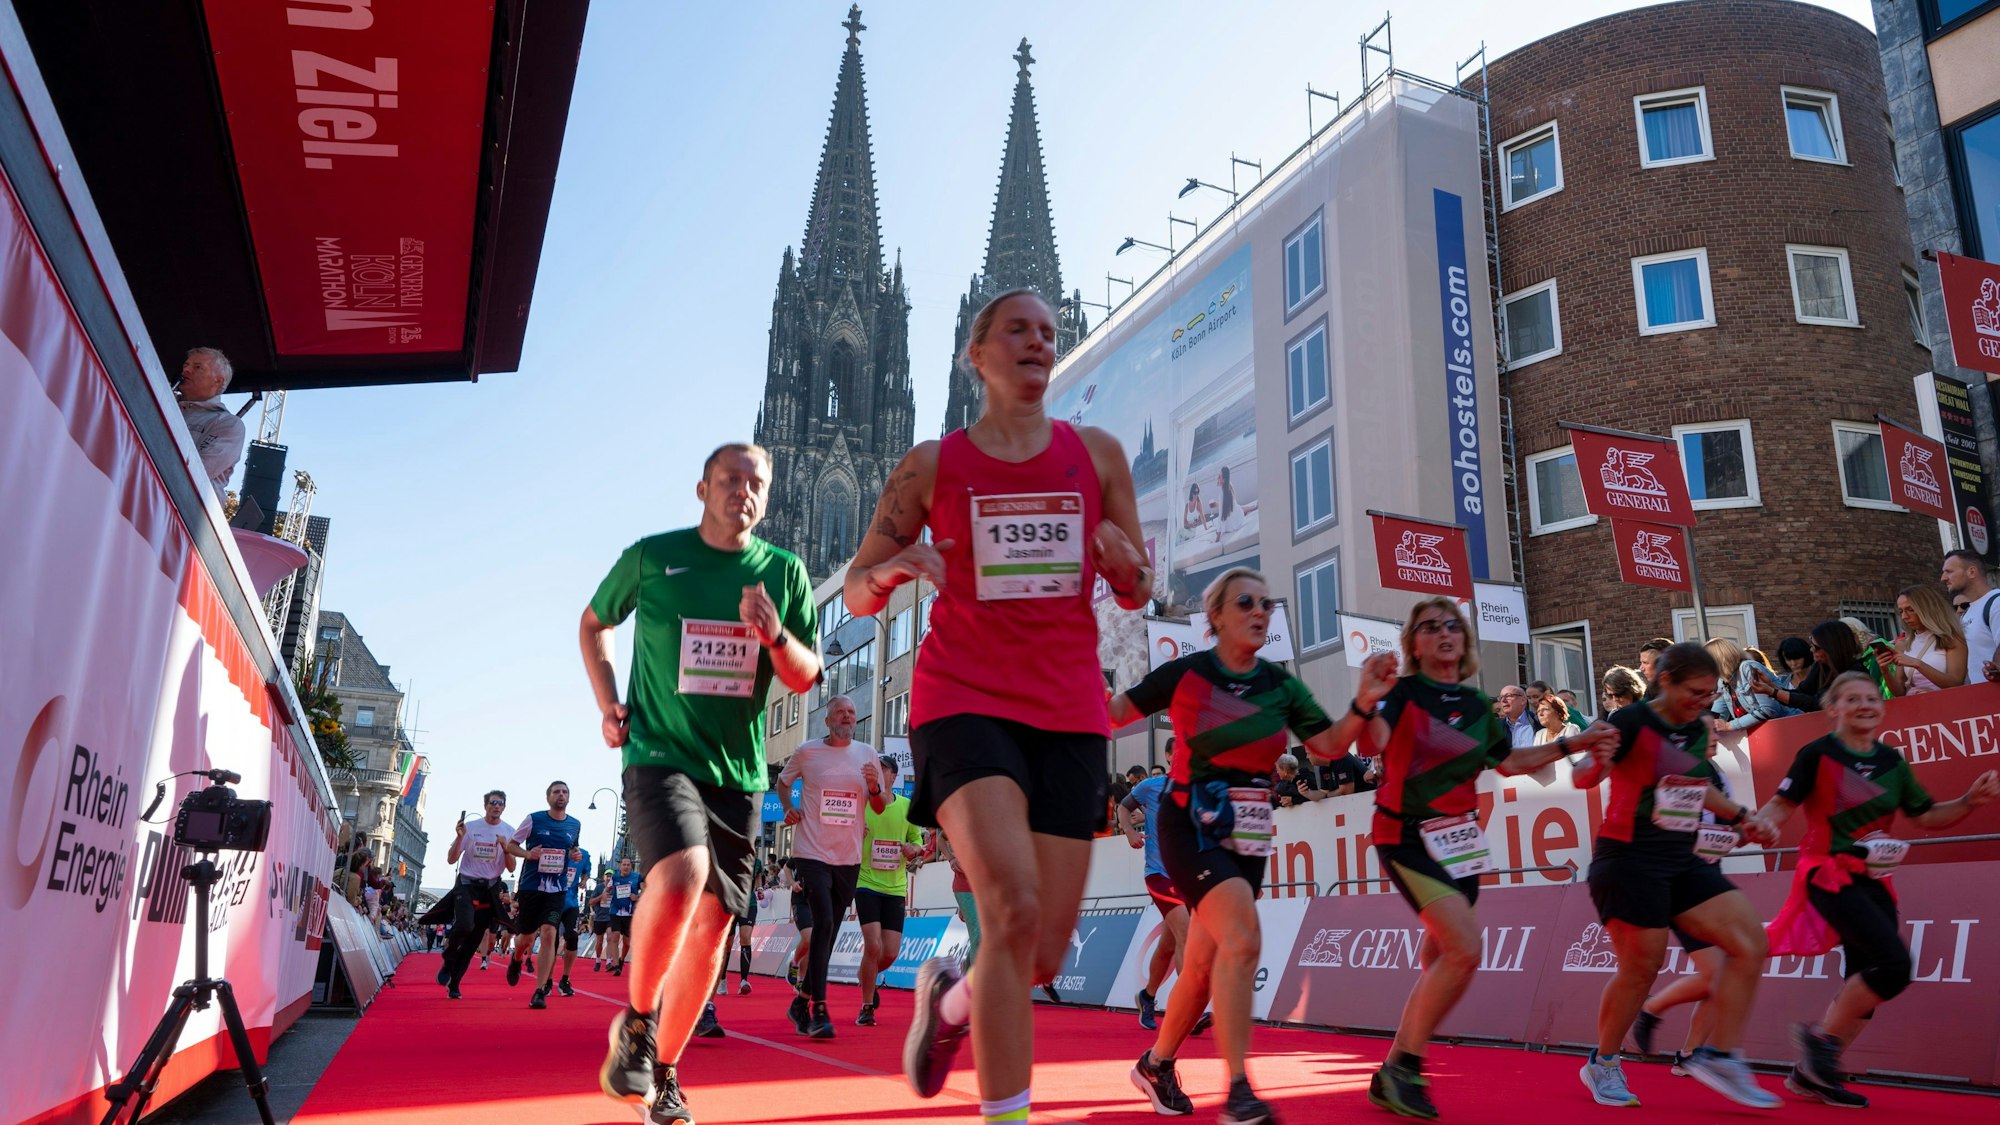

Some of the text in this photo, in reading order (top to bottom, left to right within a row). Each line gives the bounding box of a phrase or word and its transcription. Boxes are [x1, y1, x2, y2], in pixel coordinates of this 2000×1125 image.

[291, 50, 399, 170] Ziel.
[315, 237, 349, 308] MARATHON
[399, 254, 424, 307] GENERALI
[1171, 304, 1237, 362] Köln Bonn Airport
[1447, 265, 1482, 516] aohostels.com
[1945, 433, 1977, 450] Seit 2007
[1606, 491, 1671, 513] GENERALI
[1903, 483, 1943, 509] GENERALI
[987, 522, 1070, 544] 13936
[1003, 547, 1056, 560] Jasmin
[1397, 567, 1453, 587] GENERALI
[1635, 564, 1682, 583] GENERALI
[1481, 602, 1510, 615] Rhein
[1482, 612, 1521, 625] Energie
[691, 640, 747, 658] 21231
[1369, 635, 1393, 648] Rhein
[695, 656, 744, 669] Alexander
[64, 744, 129, 830] Rhein
[825, 798, 852, 808] 22853
[1433, 826, 1479, 848] 11550
[47, 820, 127, 914] Energie
